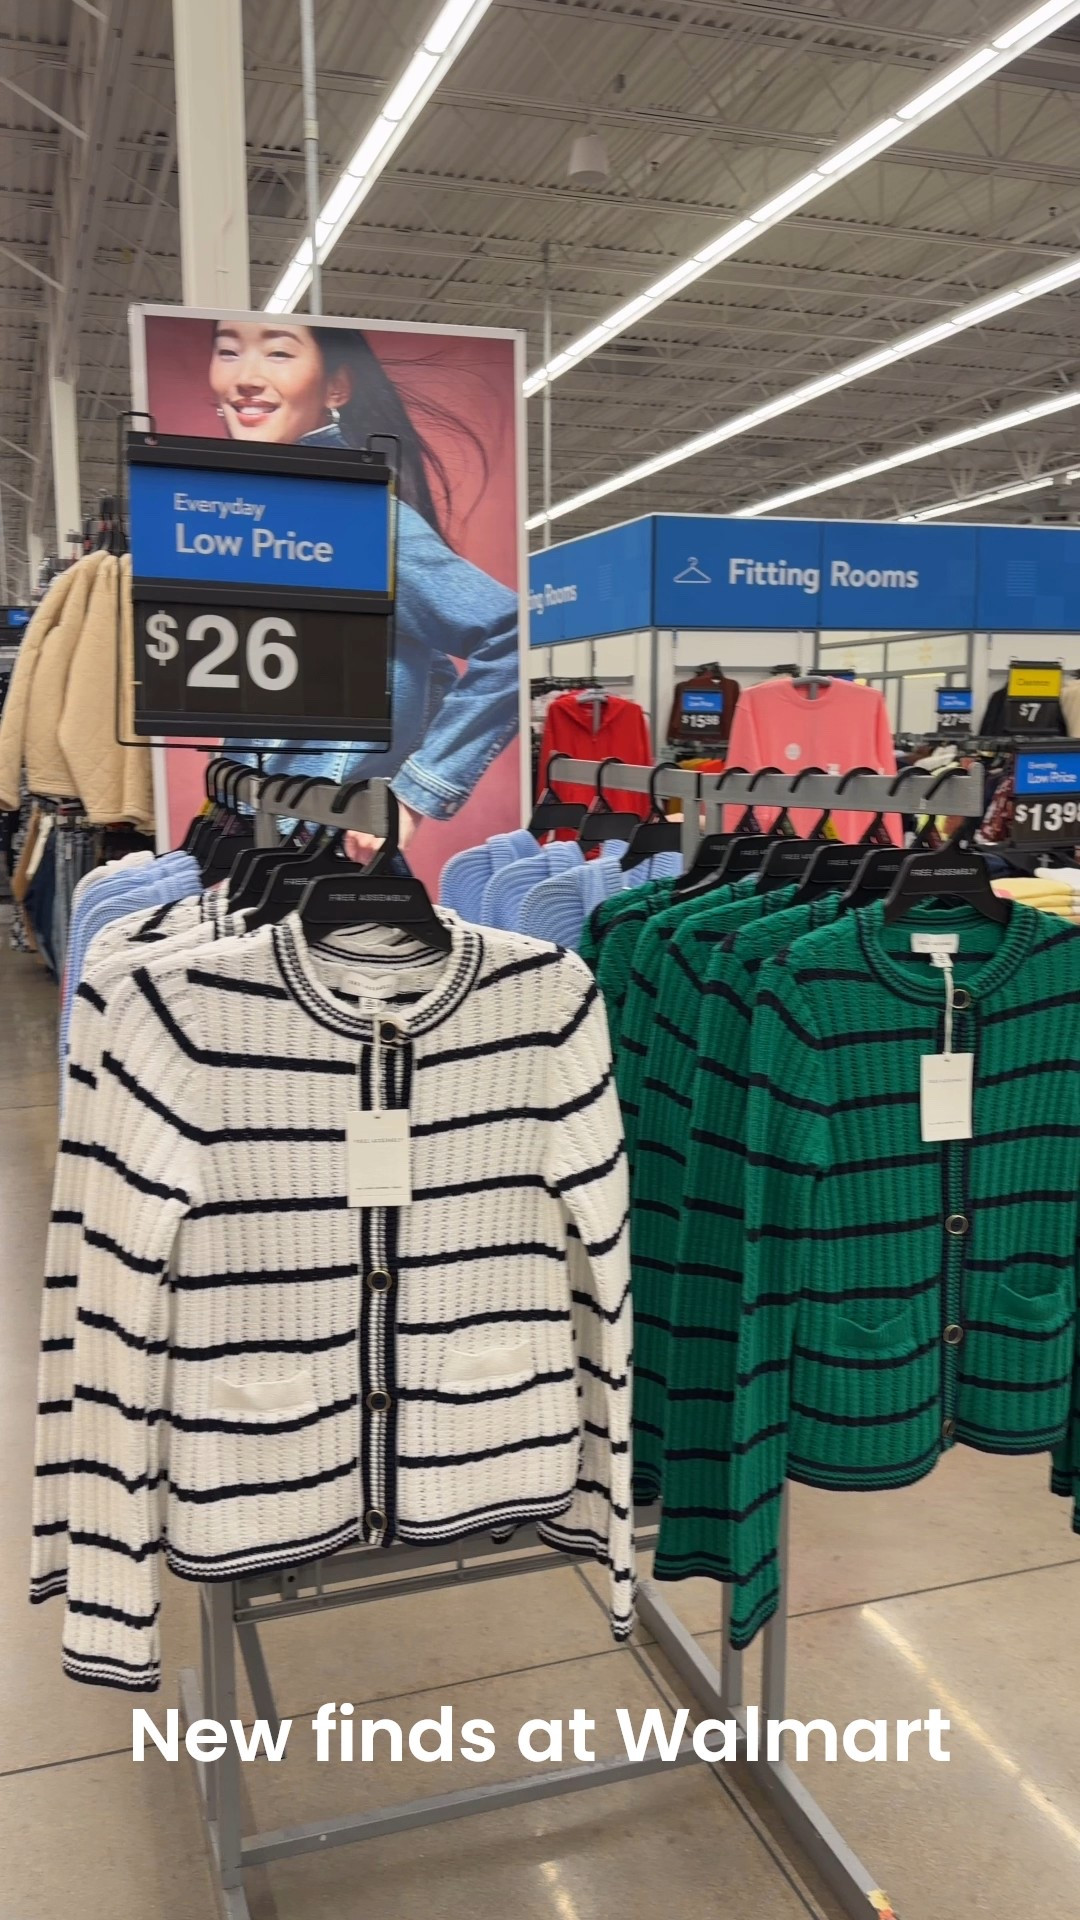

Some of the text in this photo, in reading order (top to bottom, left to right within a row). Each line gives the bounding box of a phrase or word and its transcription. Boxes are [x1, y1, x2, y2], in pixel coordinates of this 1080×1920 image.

[173, 492, 266, 521] Everyday
[175, 522, 334, 563] Low Price
[728, 557, 919, 595] Fitting Rooms
[544, 583, 577, 607] Rooms
[145, 609, 299, 691] $26
[1018, 702, 1042, 722] $7
[1027, 771, 1077, 784] Low Price
[328, 893, 413, 902] FREE ASSEMBLY
